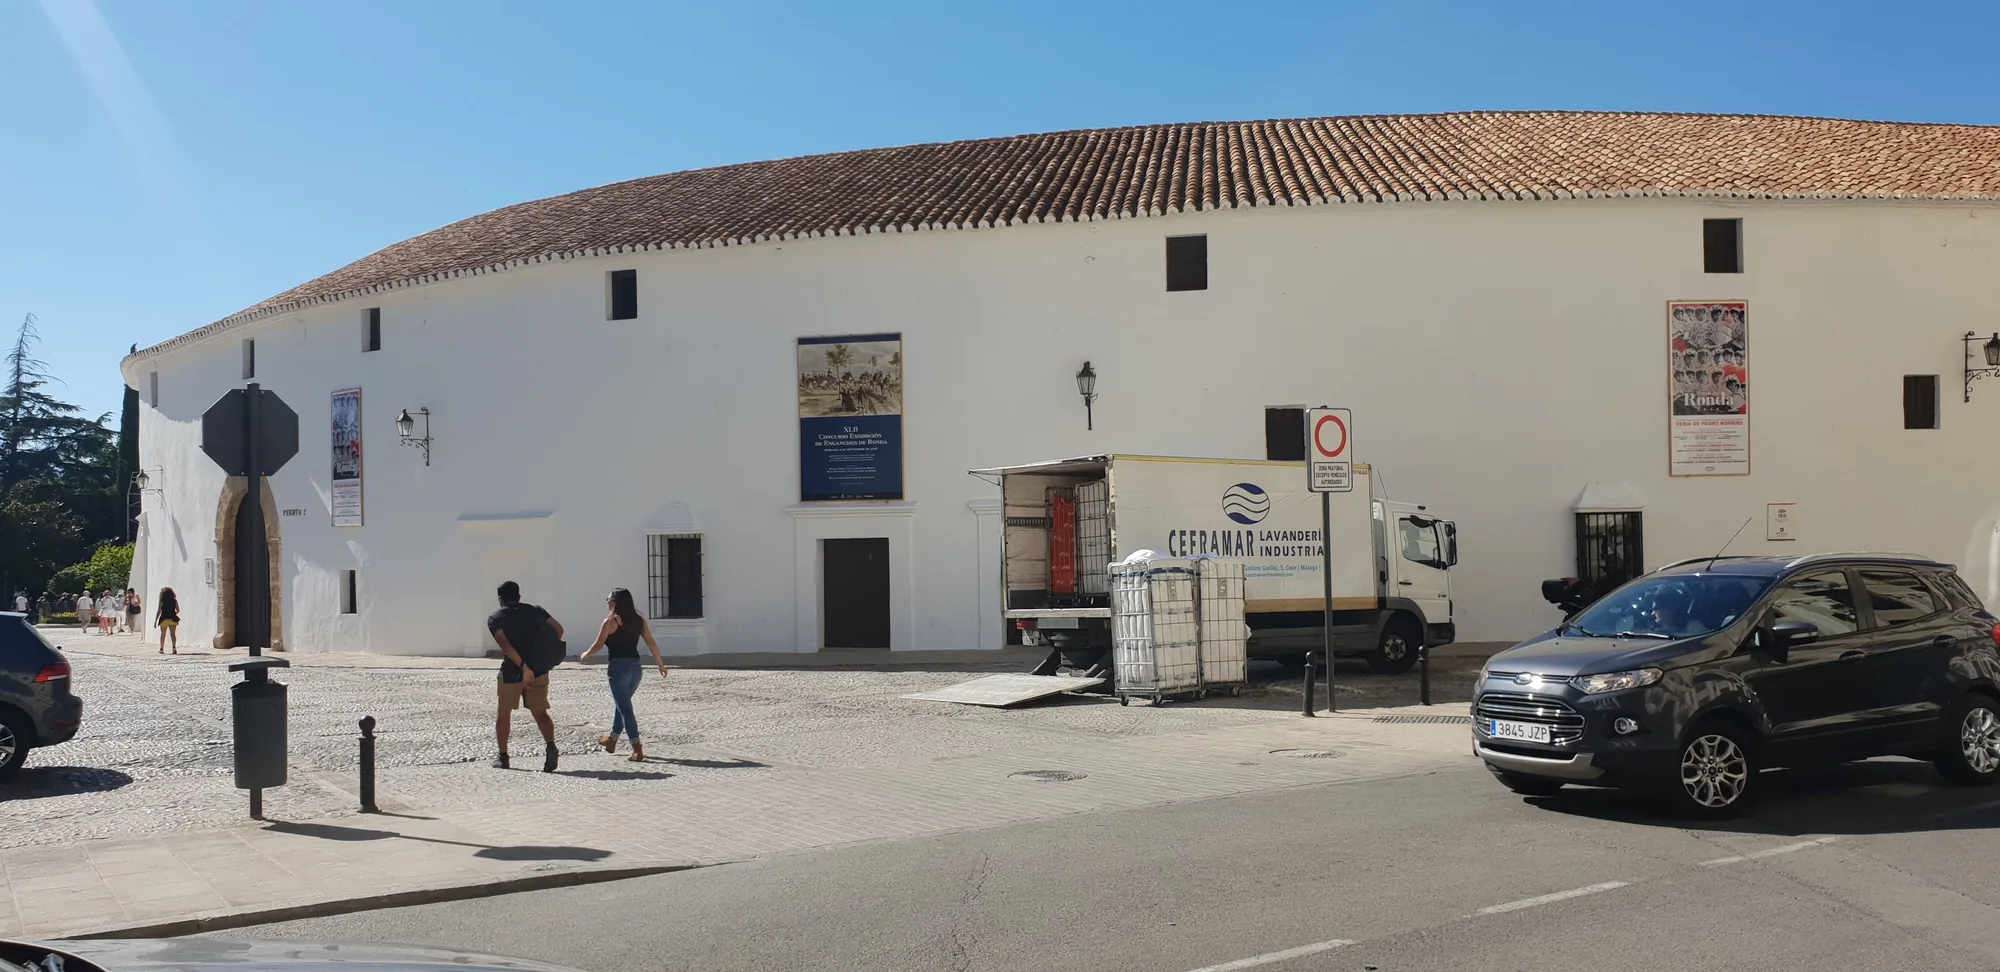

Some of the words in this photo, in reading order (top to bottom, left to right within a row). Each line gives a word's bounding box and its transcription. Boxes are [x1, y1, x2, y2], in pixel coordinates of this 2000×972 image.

[1684, 392, 1734, 406] Ronda
[1259, 528, 1324, 541] LAVANDERÍ
[1168, 529, 1254, 557] CEFRAMAR
[1260, 545, 1324, 557] INDUSTRIA
[1498, 723, 1524, 738] 3845
[1527, 726, 1547, 740] JZP
